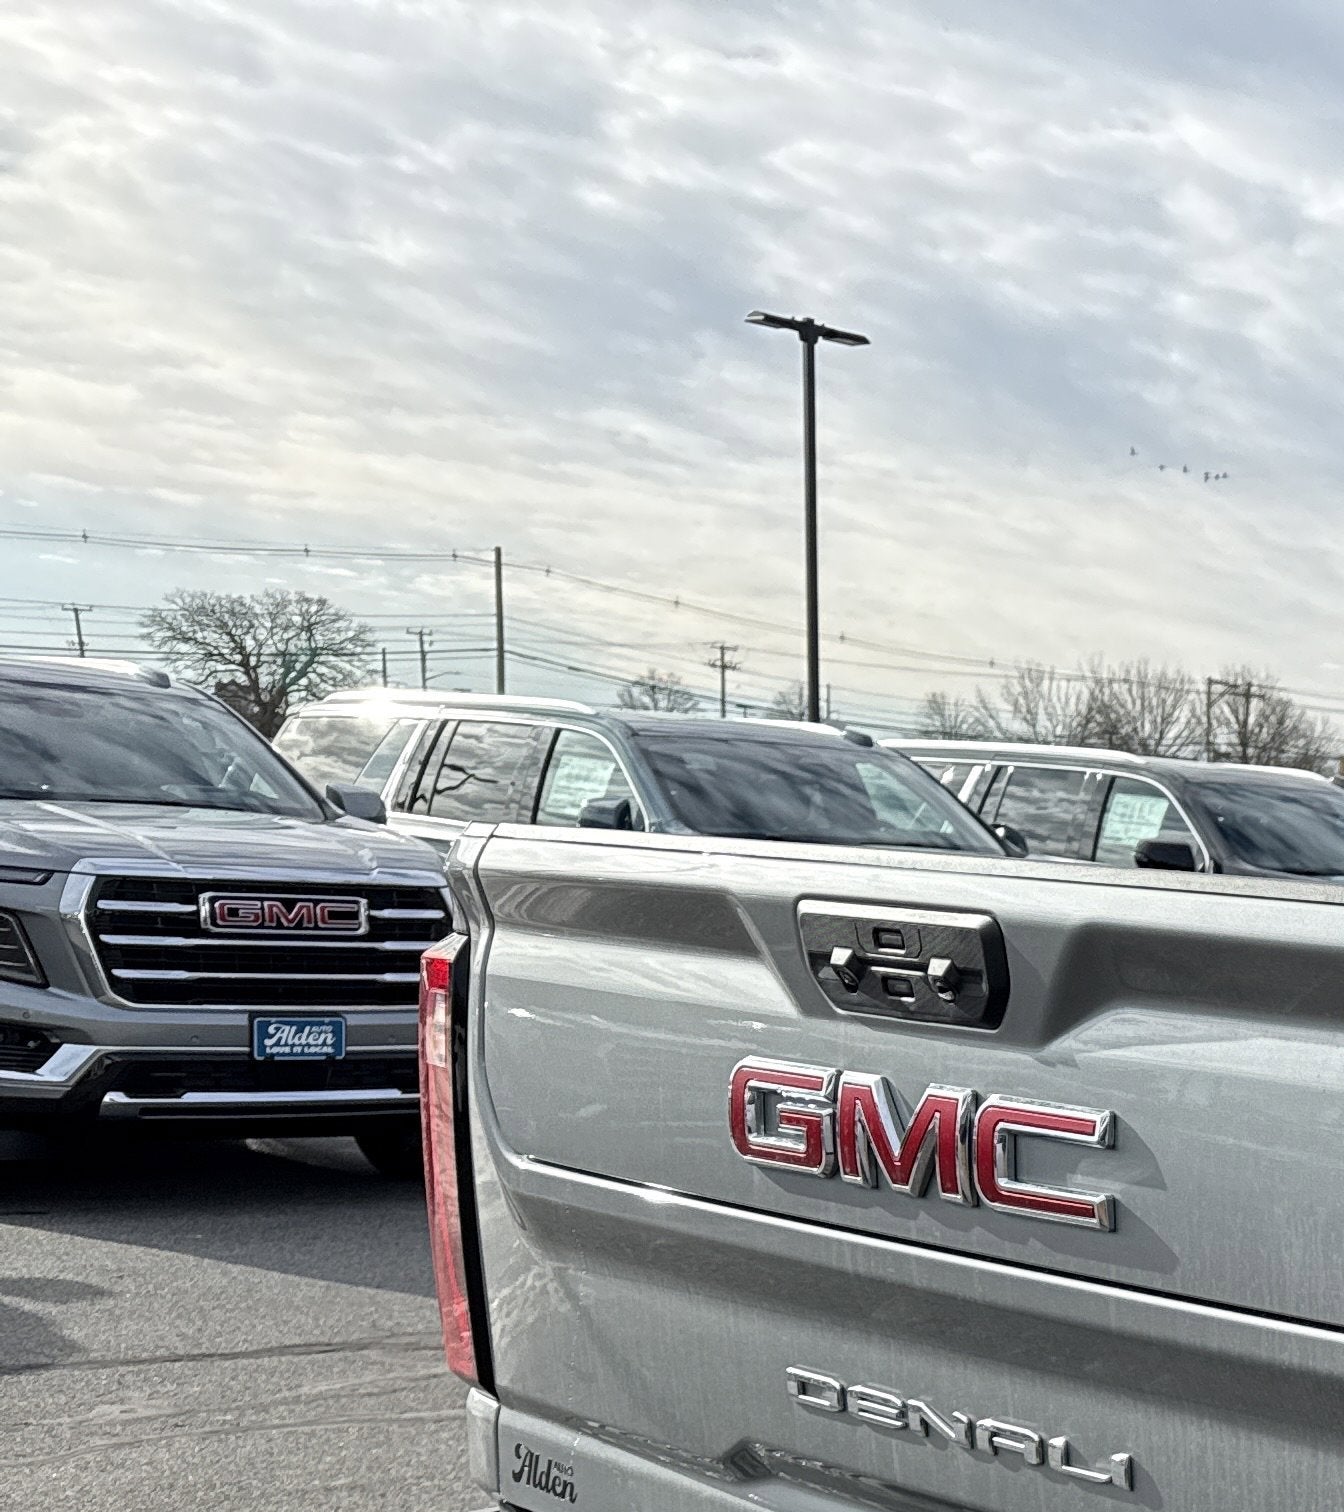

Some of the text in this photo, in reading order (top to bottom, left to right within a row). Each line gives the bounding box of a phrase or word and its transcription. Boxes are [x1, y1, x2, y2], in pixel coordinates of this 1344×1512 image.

[214, 900, 359, 928] GMC
[263, 1023, 336, 1046] Alden
[728, 1055, 1116, 1232] GMC
[786, 1365, 1133, 1492] DENALI
[511, 1443, 578, 1504] Alden
